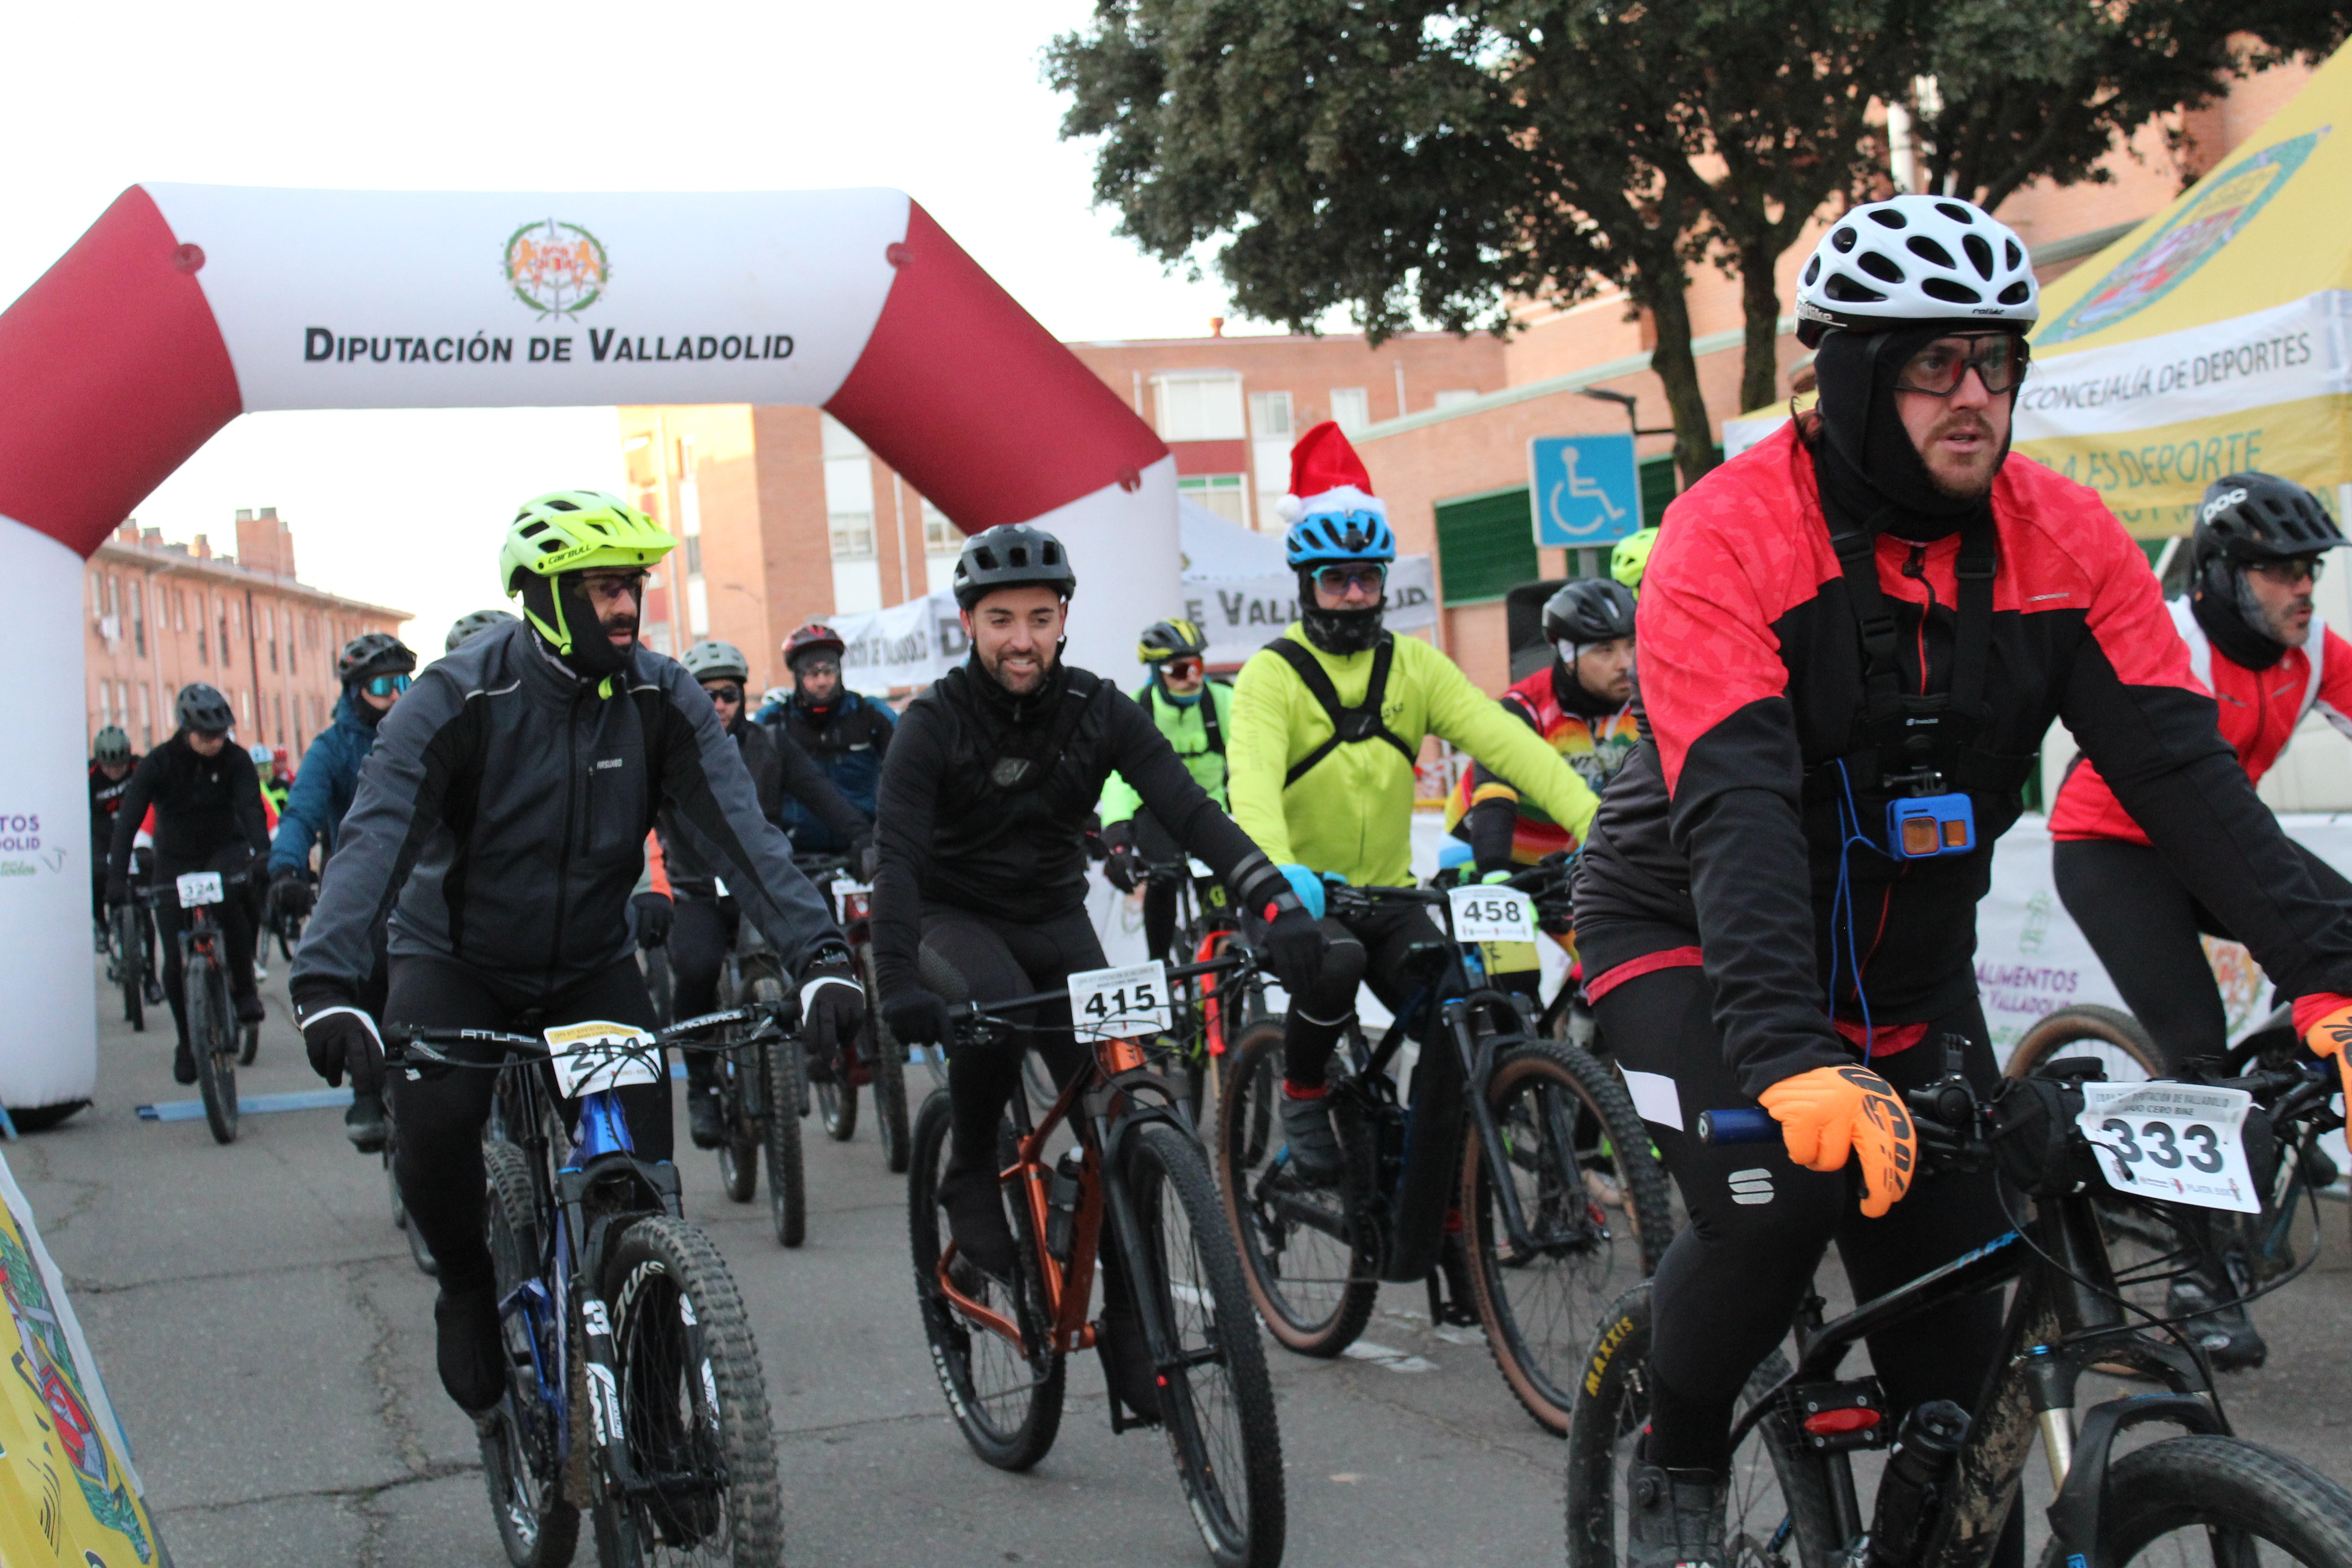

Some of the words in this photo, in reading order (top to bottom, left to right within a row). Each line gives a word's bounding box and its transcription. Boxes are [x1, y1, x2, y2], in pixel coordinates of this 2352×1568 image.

[304, 327, 513, 363] DIPUTACIÓN
[528, 337, 572, 362] DE
[588, 328, 794, 362] VALLADOLID
[2159, 362, 2188, 394] DE
[2194, 333, 2312, 386] DEPORTES
[2119, 429, 2263, 488] DEPORTE
[1464, 901, 1521, 922] 458
[1085, 984, 1156, 1018] 415
[2102, 1118, 2224, 1173] 333
[1585, 1316, 1634, 1397] MAXXIS
